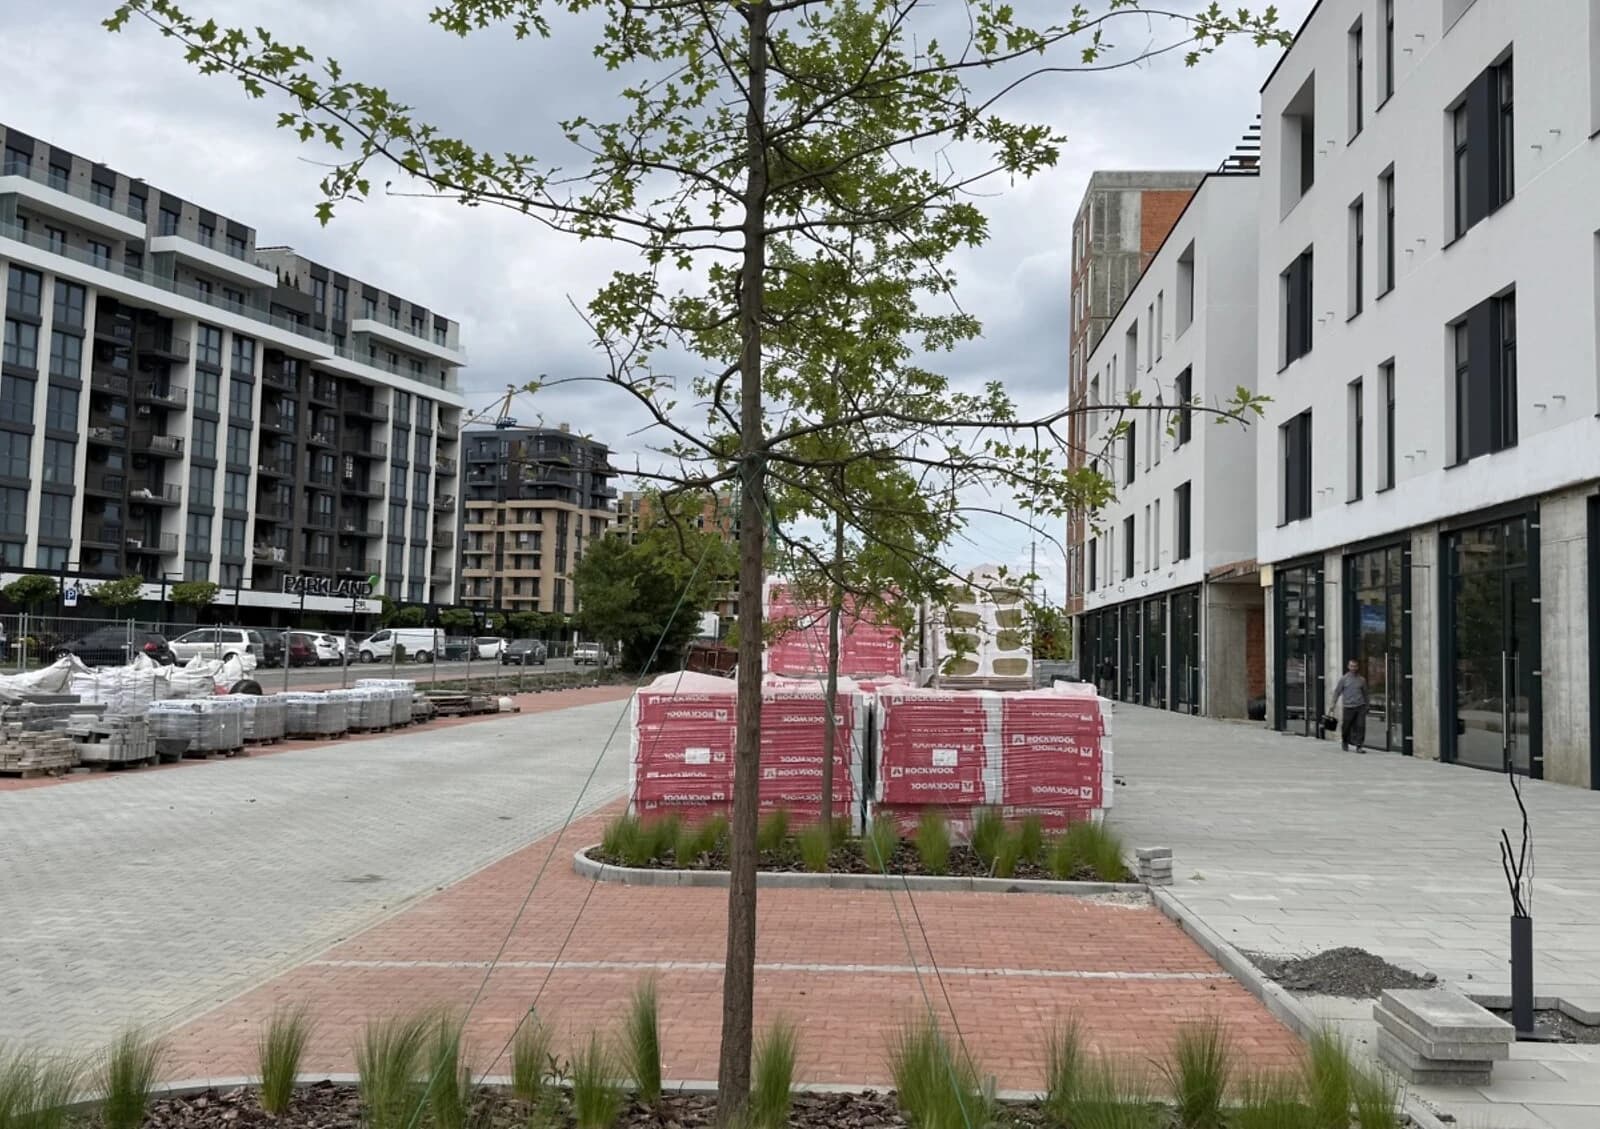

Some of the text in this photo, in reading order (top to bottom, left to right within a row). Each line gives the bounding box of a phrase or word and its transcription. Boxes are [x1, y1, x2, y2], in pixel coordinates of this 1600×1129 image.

[284, 575, 374, 597] PARKLAND
[911, 782, 960, 790] ROCKWOOL
[1031, 785, 1079, 795] ROCKWOOL
